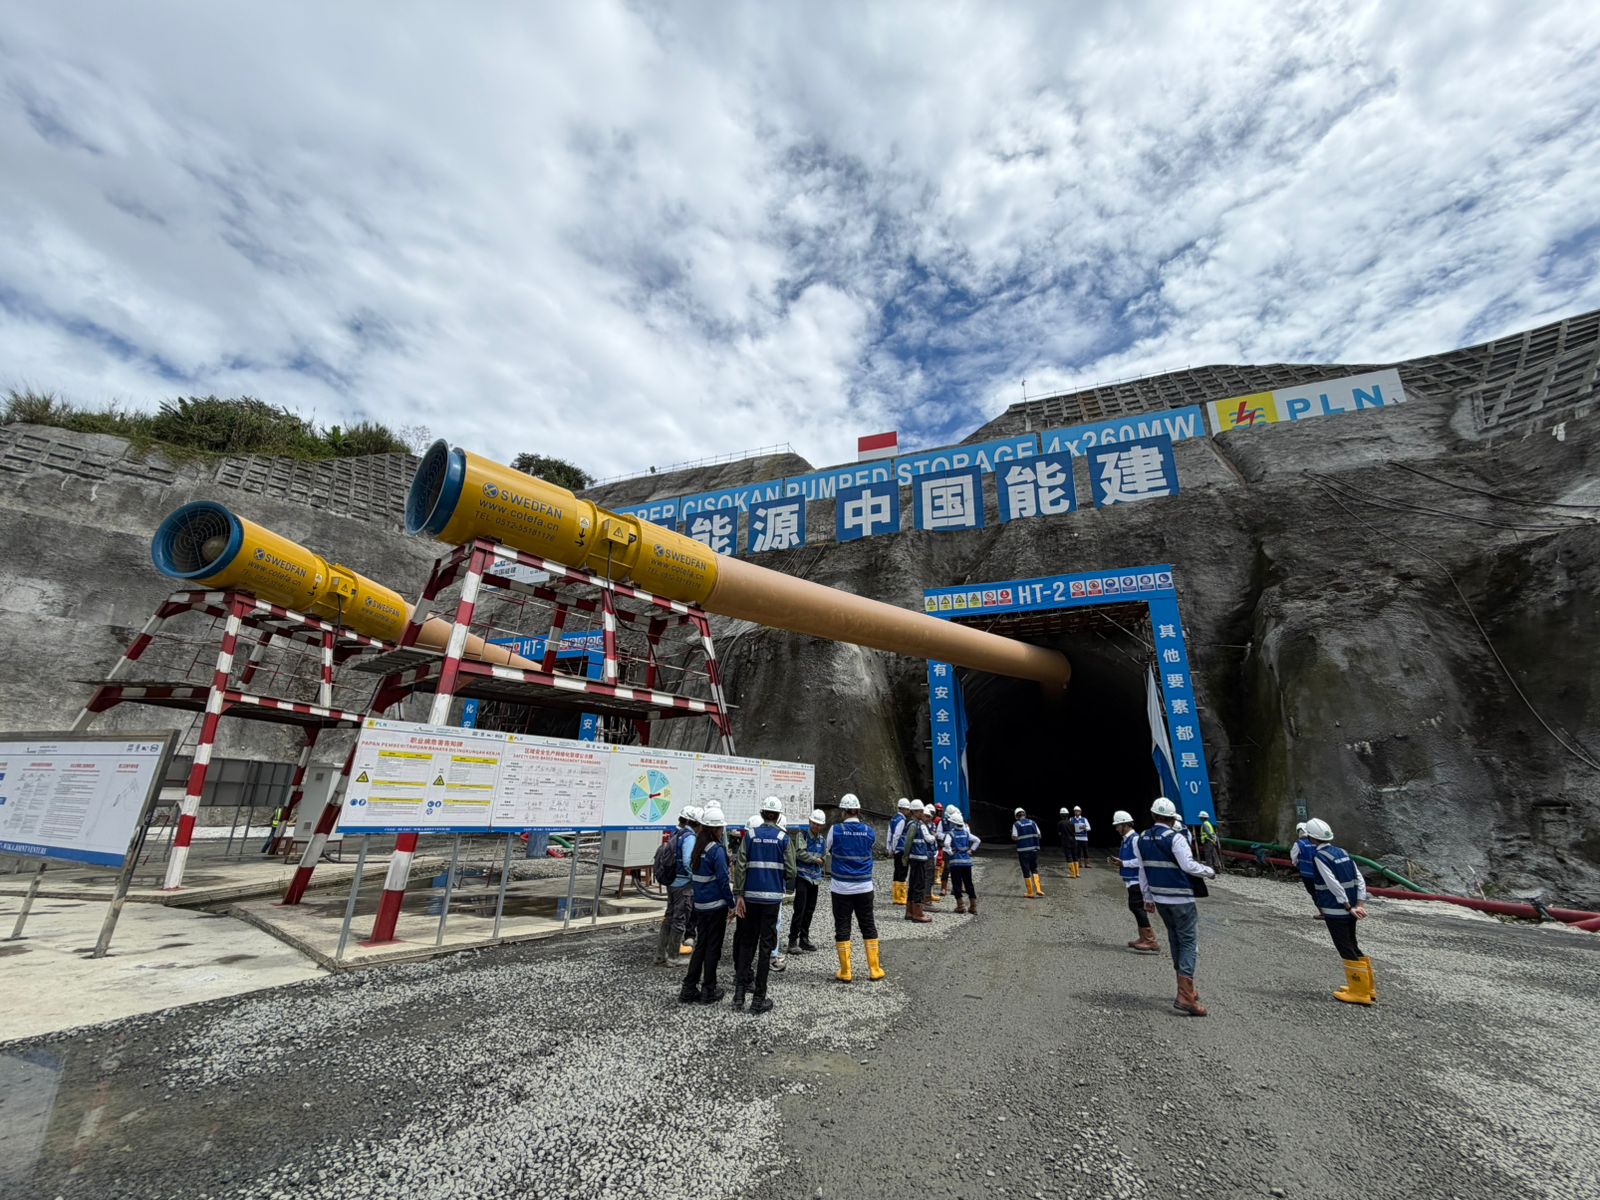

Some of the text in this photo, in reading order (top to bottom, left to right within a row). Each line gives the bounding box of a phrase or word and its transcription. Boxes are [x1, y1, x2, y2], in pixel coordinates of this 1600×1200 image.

[1286, 385, 1385, 423] PLN
[683, 485, 780, 520] CISOKAN
[787, 467, 889, 502] PUMPED
[897, 441, 1033, 486] STORAGE
[1047, 413, 1195, 458] 4x260MW
[480, 499, 560, 531] www.cotefa.cn
[501, 489, 563, 519] SWEDFAN
[265, 553, 307, 578] SWEDFAN
[666, 549, 706, 571] SWEDFAN
[1018, 581, 1066, 605] HT-2
